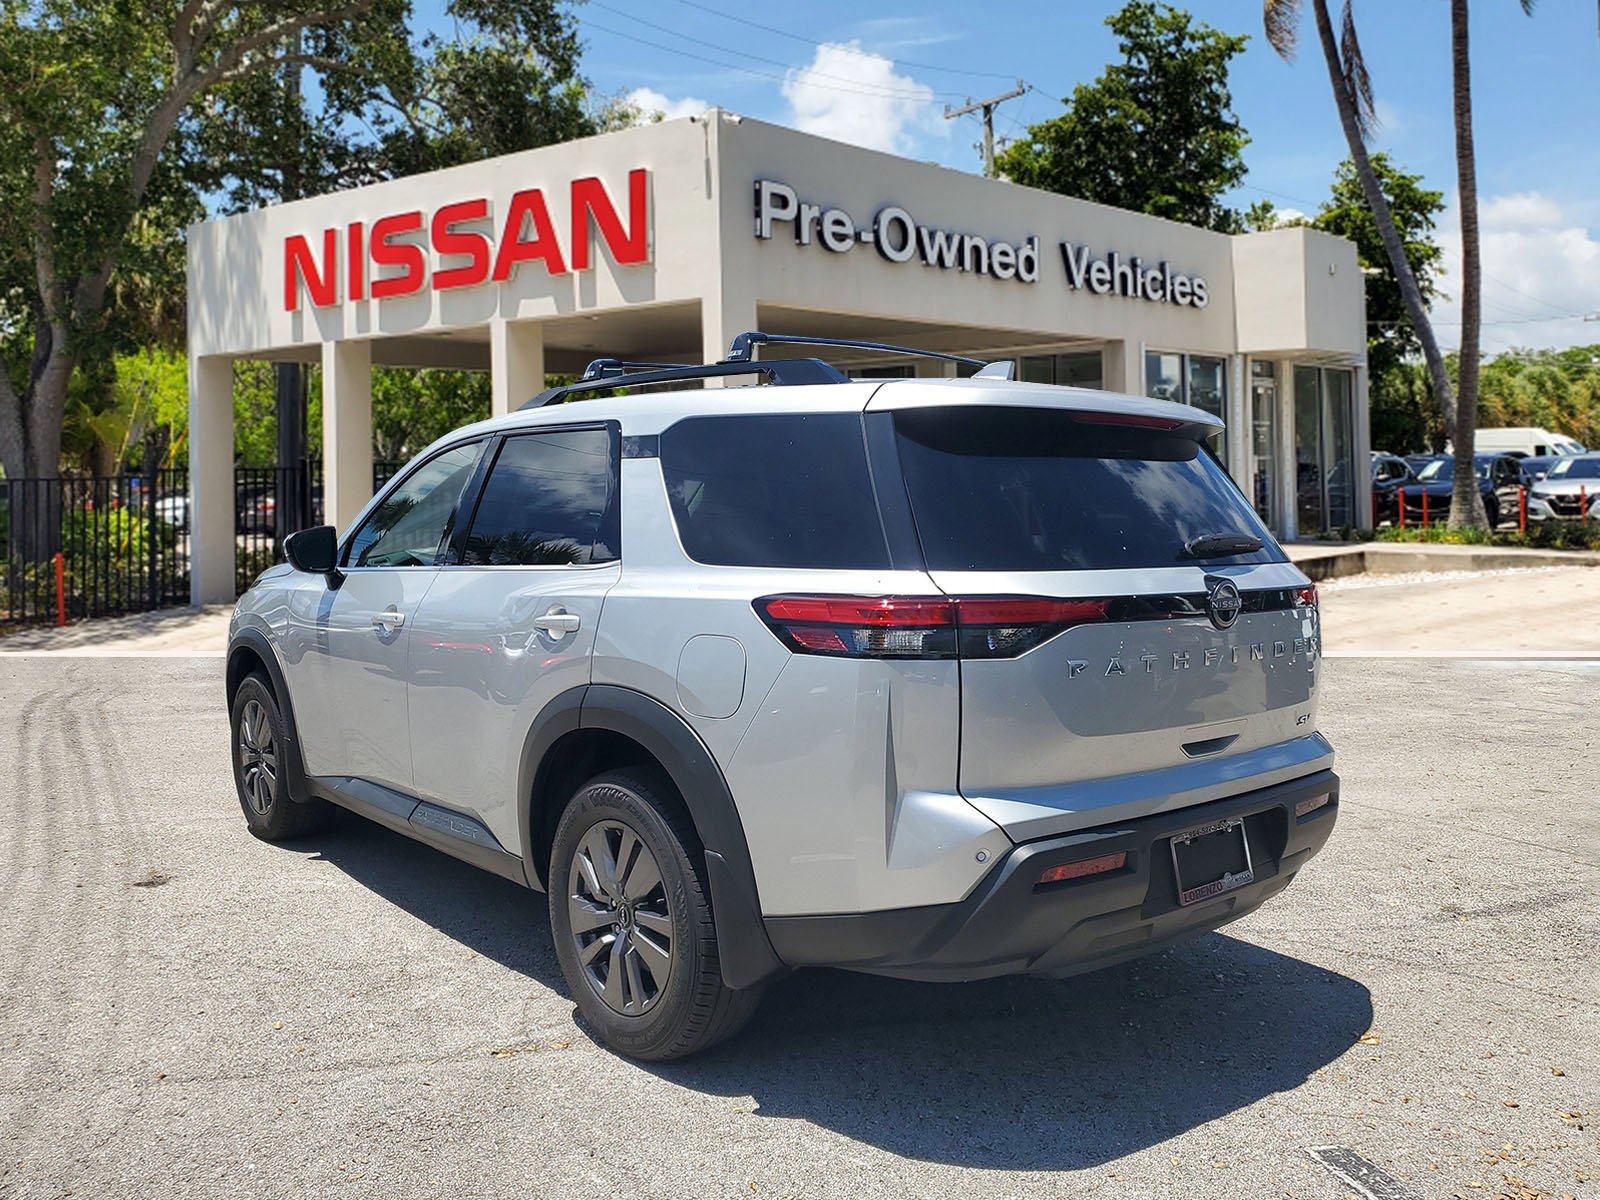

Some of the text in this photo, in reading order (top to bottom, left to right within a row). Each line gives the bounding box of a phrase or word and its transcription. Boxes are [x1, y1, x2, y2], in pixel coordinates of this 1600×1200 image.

[284, 168, 650, 312] NISSAN
[754, 179, 1208, 308] Pre-Owned Vehicles
[1066, 637, 1319, 679] PATHFINDER
[1183, 881, 1224, 903] LORENZO
